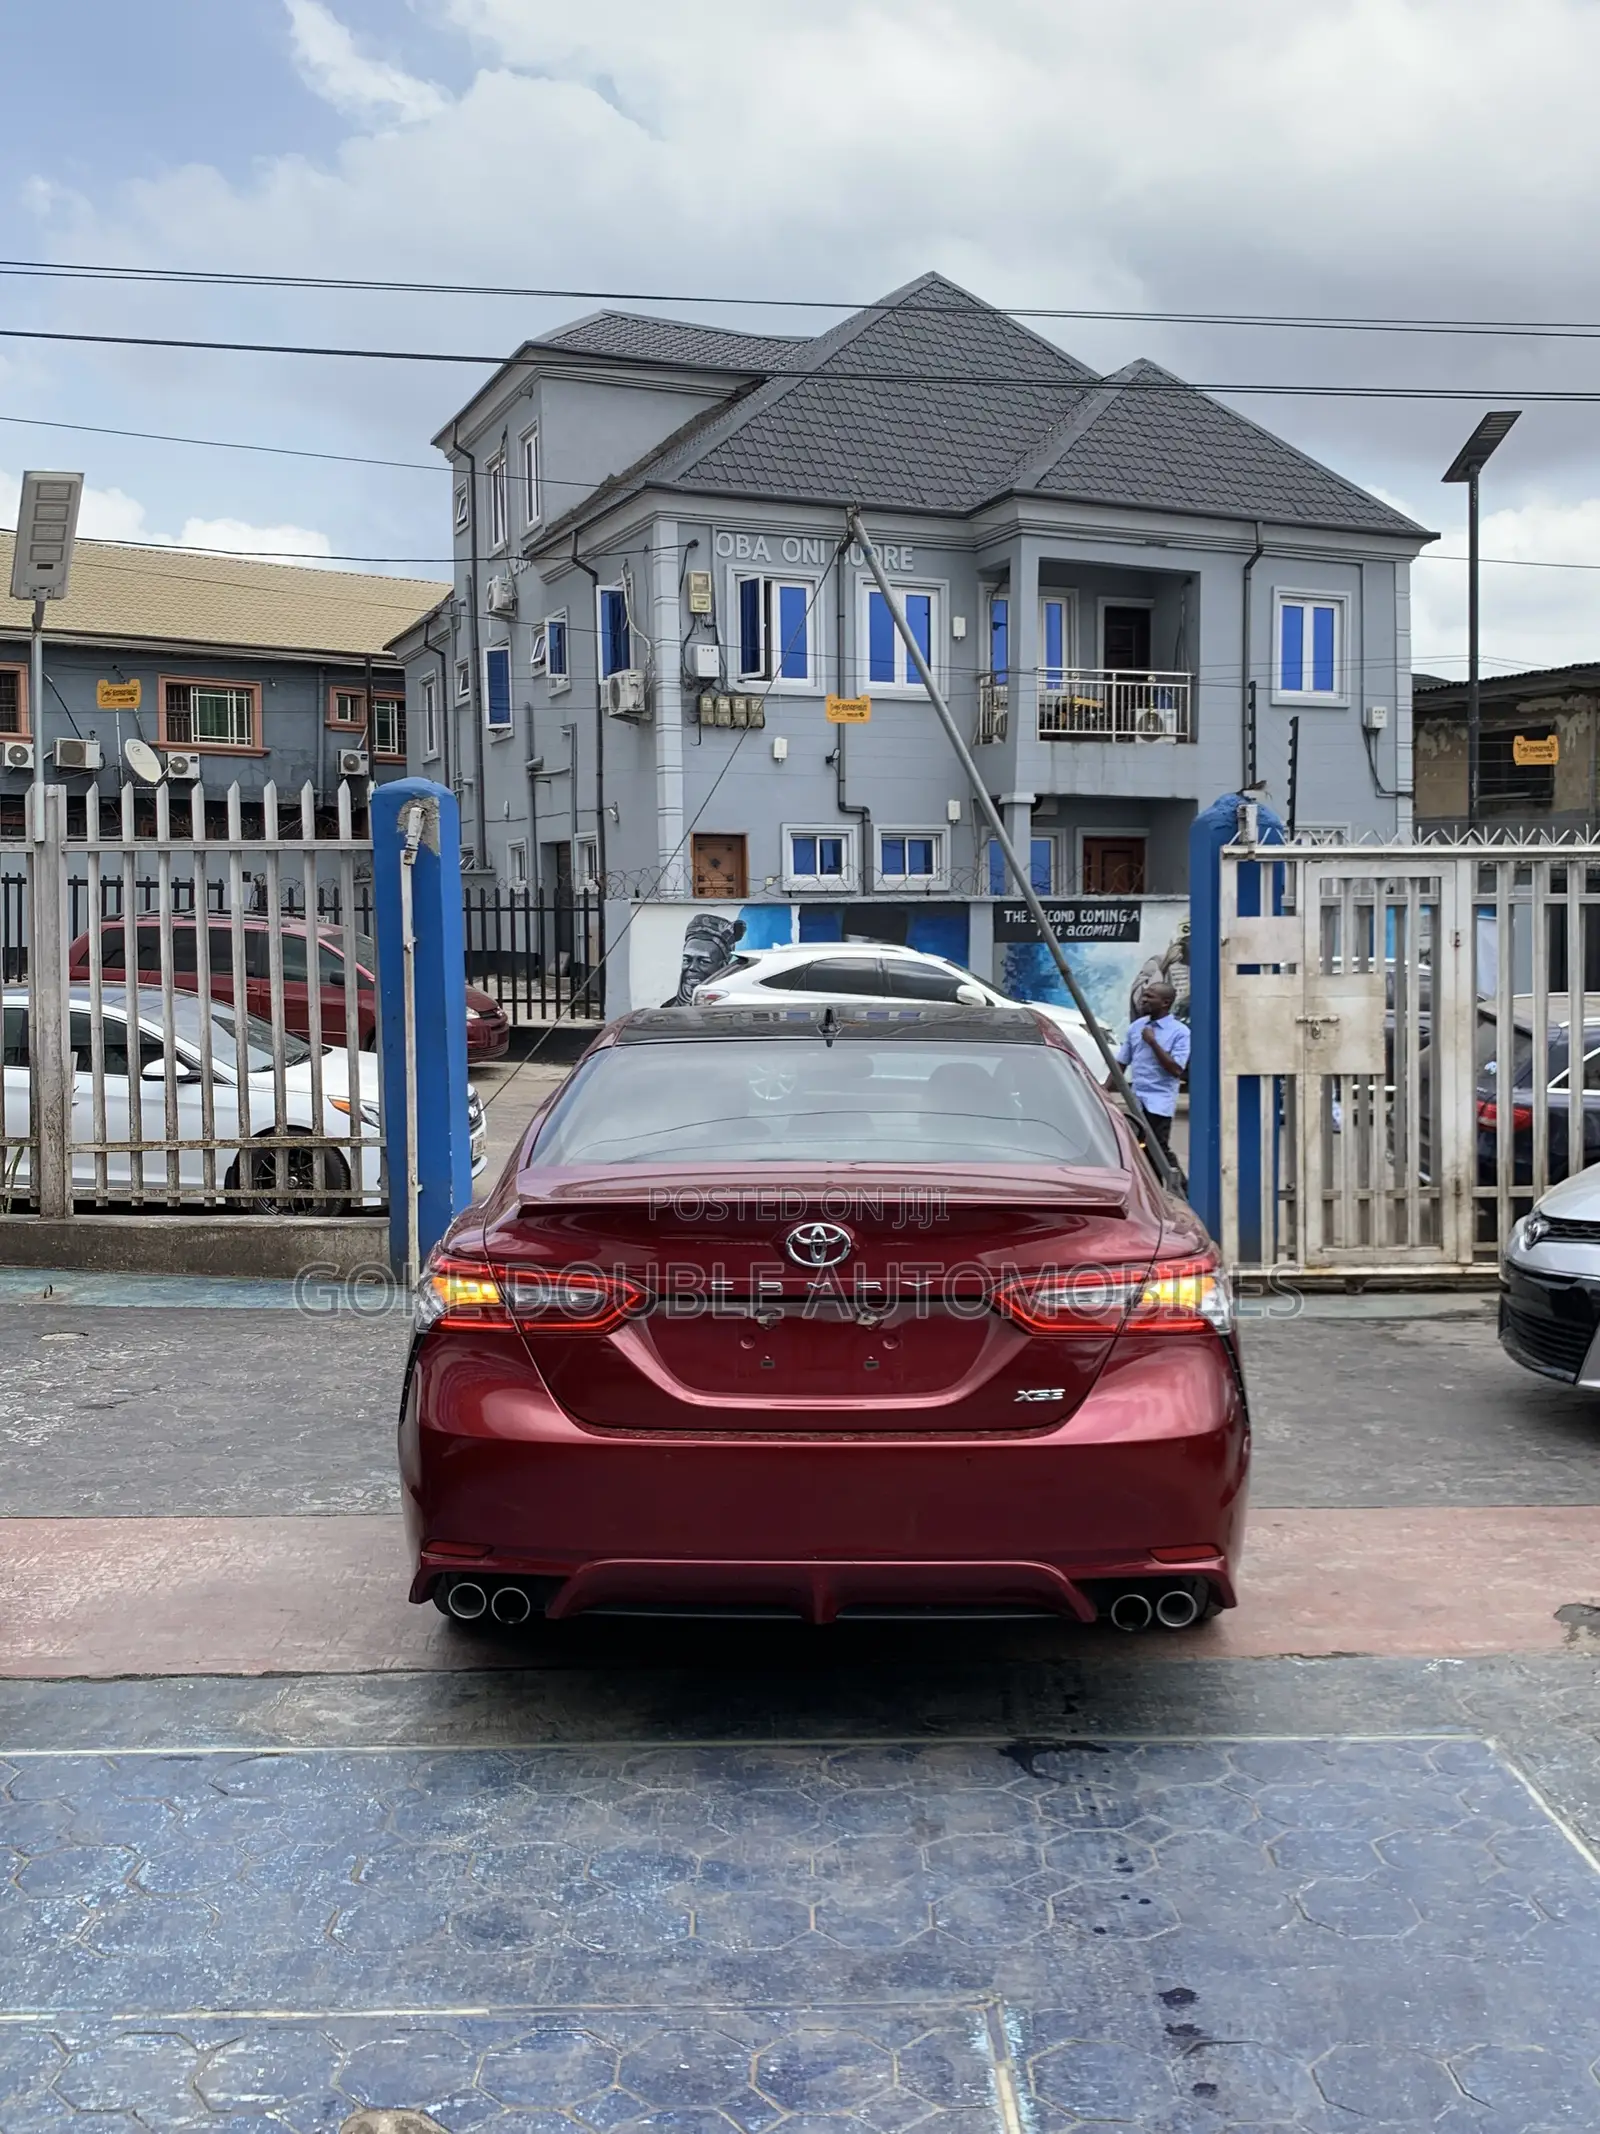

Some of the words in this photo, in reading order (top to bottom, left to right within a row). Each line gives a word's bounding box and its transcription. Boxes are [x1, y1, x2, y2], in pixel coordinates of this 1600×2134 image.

[716, 532, 772, 562] OBA
[781, 537, 826, 565] ONI
[1004, 910, 1027, 923] THE
[1014, 1388, 1066, 1402] XSE
